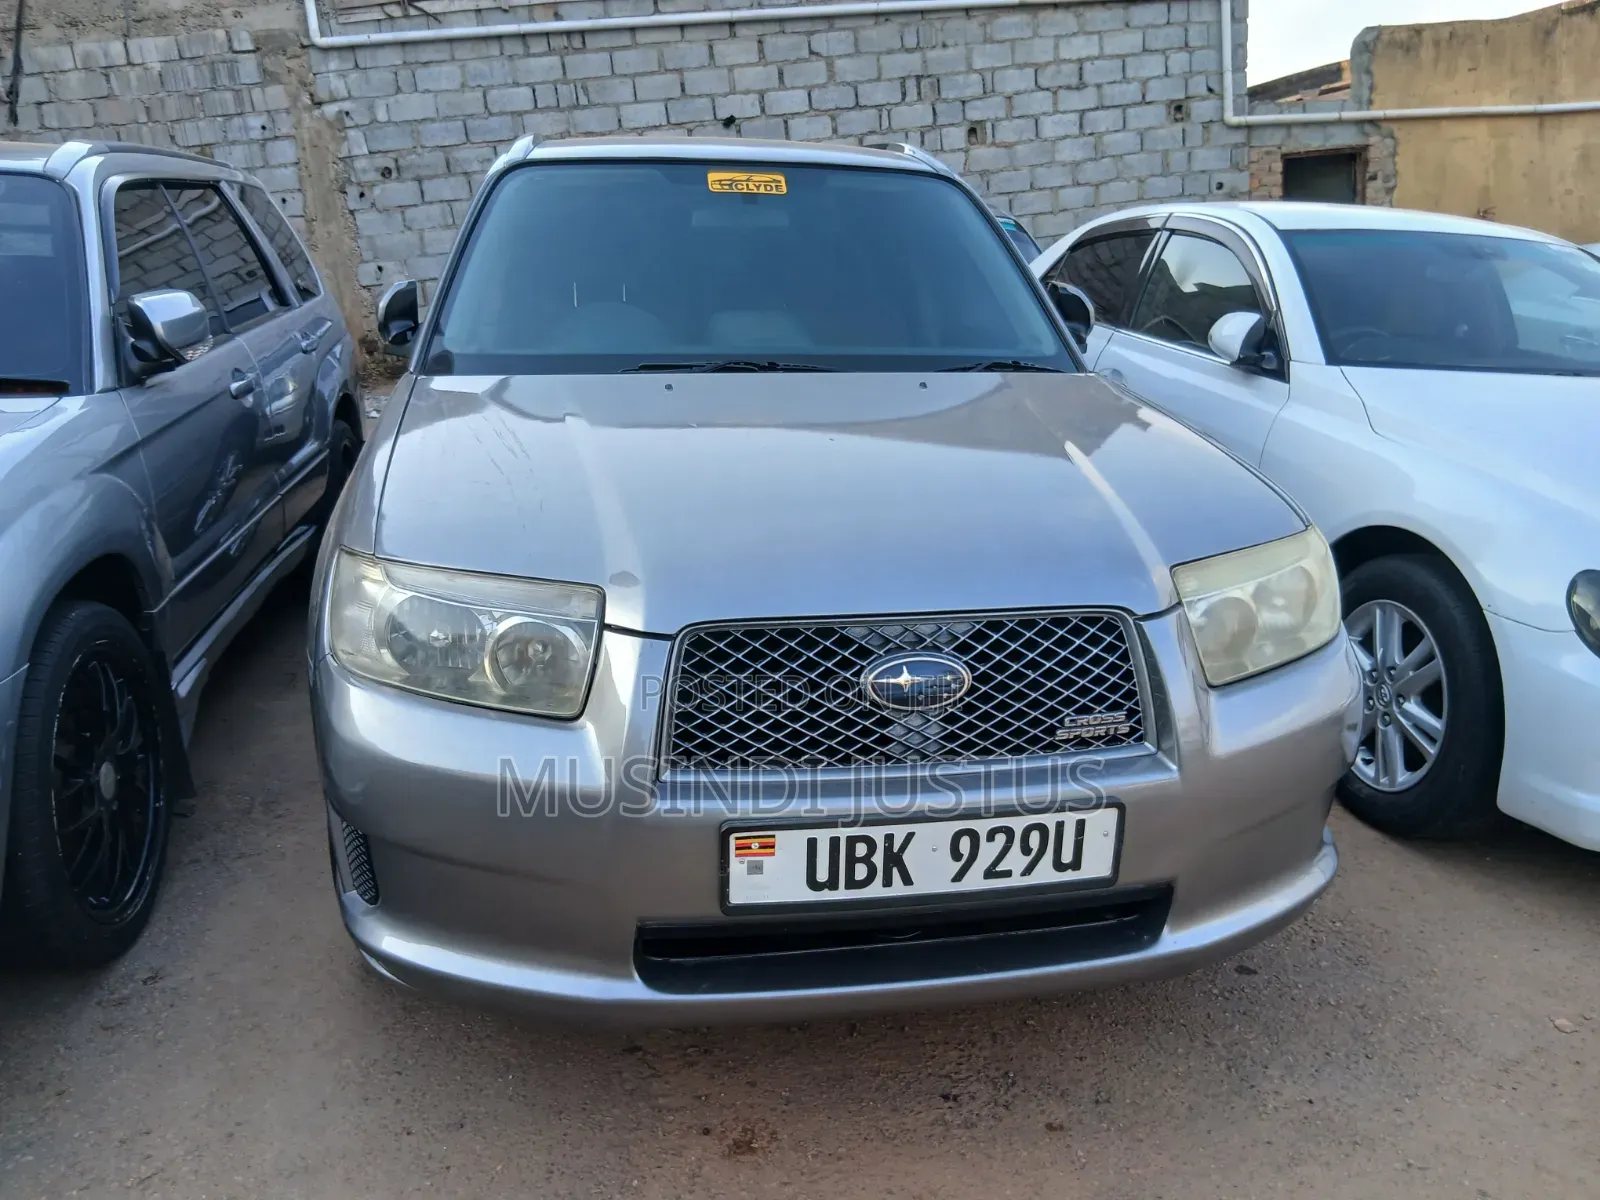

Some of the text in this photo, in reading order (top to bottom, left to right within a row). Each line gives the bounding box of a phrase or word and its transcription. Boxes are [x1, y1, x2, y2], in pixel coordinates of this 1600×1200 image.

[733, 182, 785, 193] CLYDE
[1064, 711, 1128, 727] CROSS
[1055, 724, 1131, 740] SPORTS
[806, 818, 1086, 892] UBK 929U
